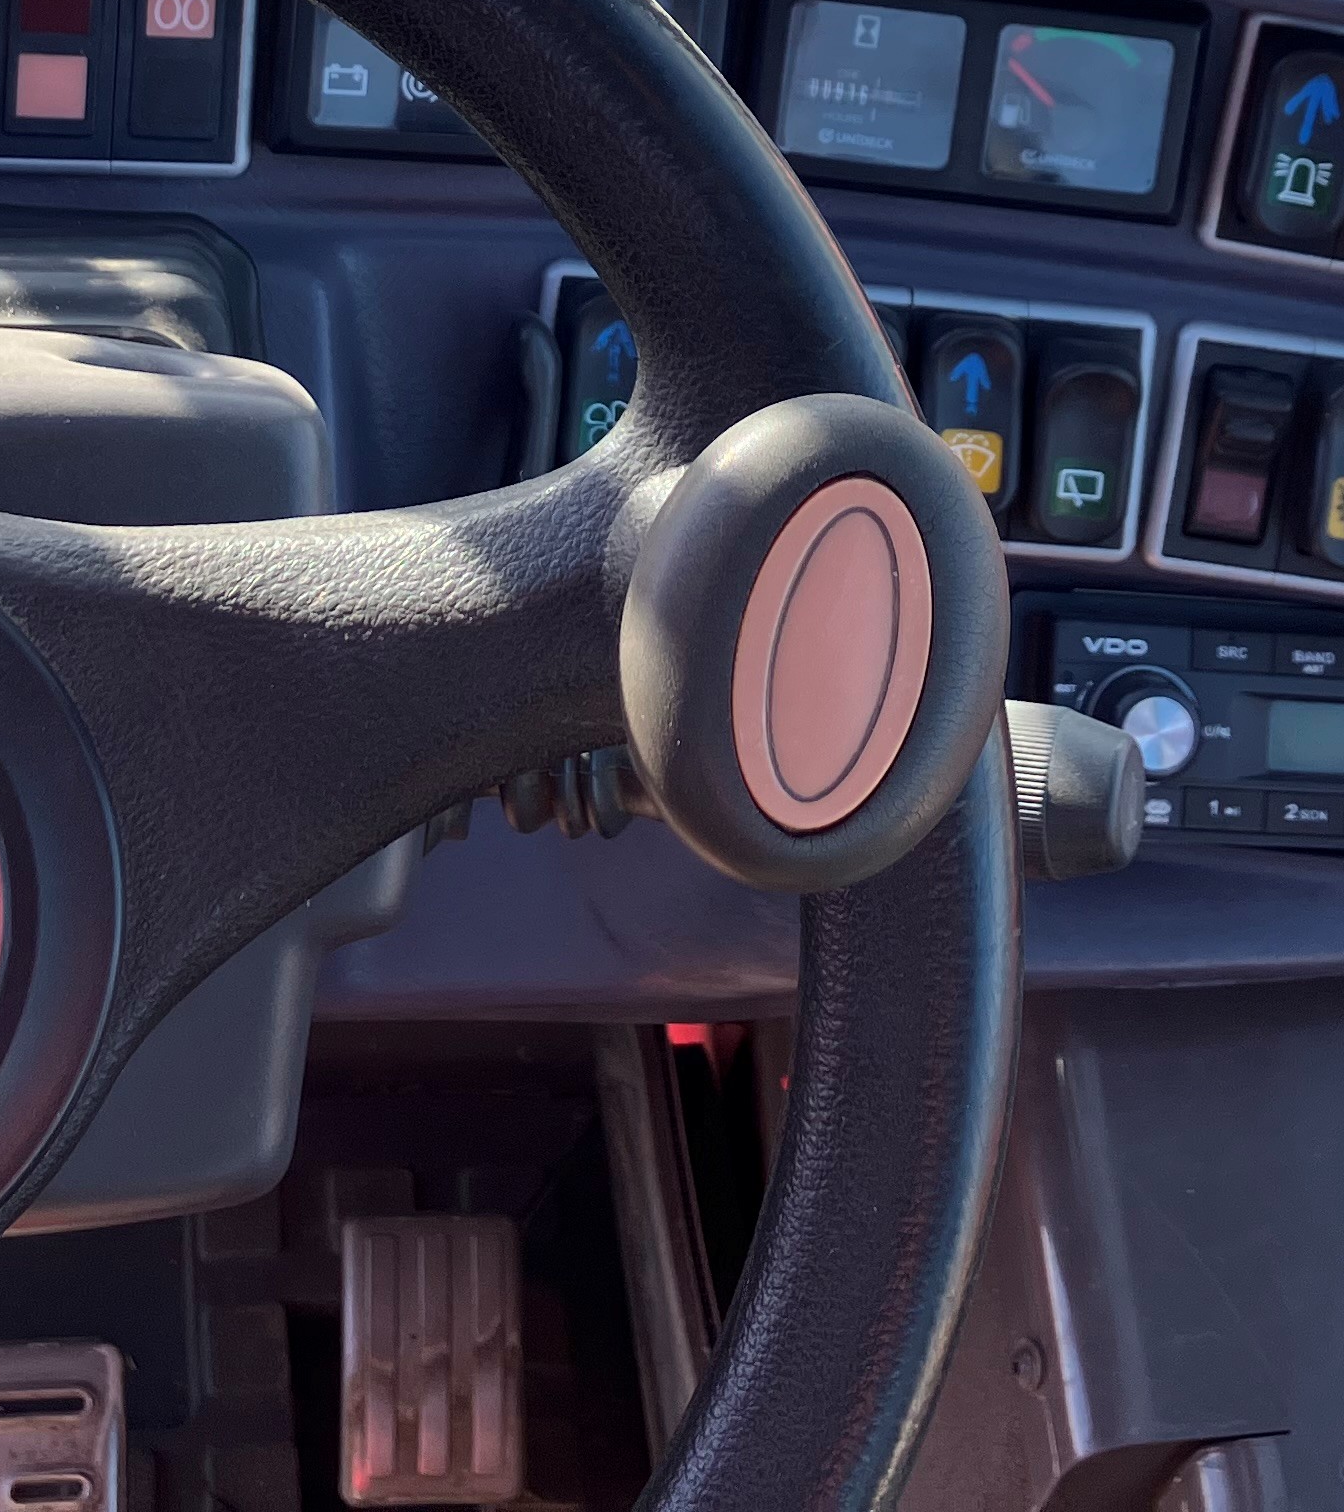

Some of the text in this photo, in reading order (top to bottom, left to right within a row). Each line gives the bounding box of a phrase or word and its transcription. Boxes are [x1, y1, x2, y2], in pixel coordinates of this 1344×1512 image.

[1082, 636, 1149, 657] VDO
[1216, 645, 1249, 660] SRC
[1291, 649, 1336, 664] BAND
[1208, 799, 1220, 817] 1
